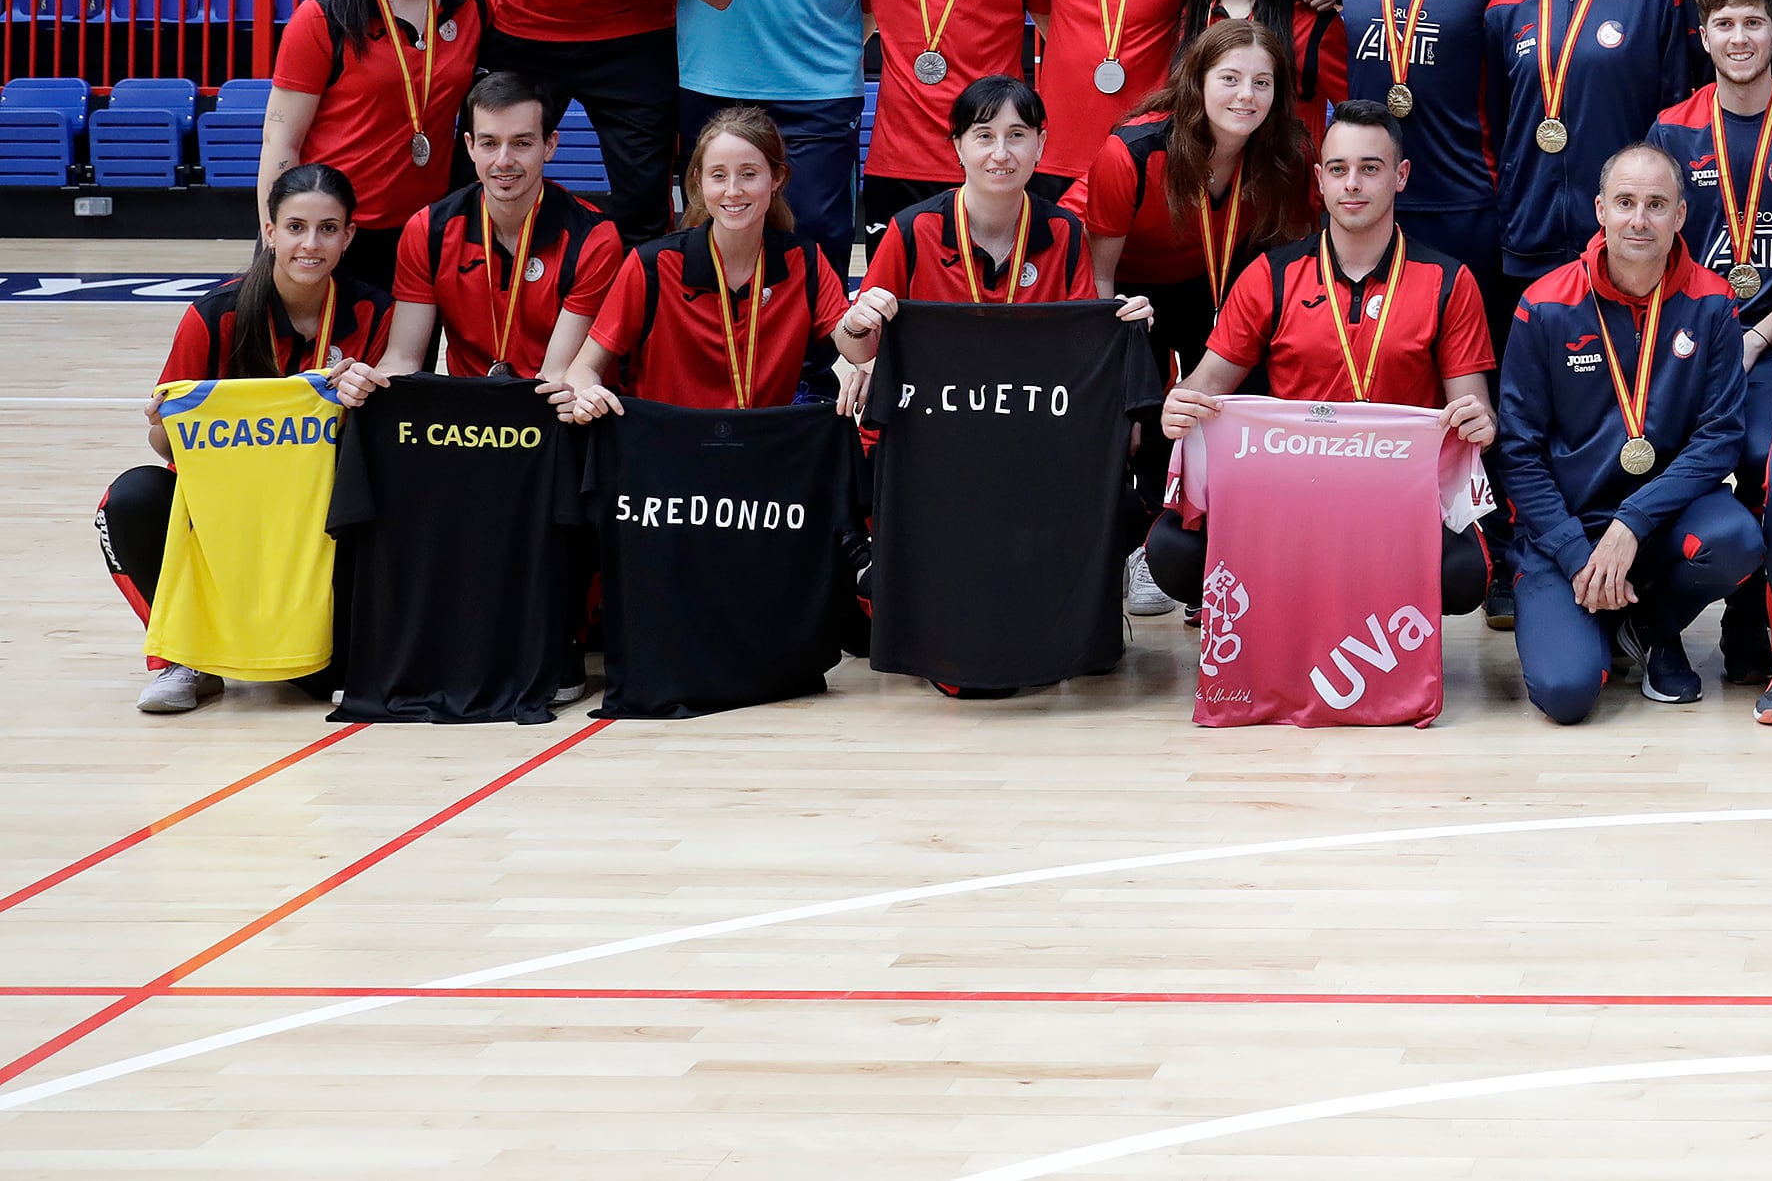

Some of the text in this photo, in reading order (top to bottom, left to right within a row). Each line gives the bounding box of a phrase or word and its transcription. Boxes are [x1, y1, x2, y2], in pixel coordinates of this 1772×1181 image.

[1566, 353, 1602, 366] Joma
[1574, 365, 1596, 373] Sanse
[177, 416, 338, 451] V.CASADO
[398, 422, 542, 449] F. CASADO
[1234, 426, 1413, 460] J. González
[615, 495, 805, 531] S.REDONDO
[1308, 603, 1435, 711] UVa
